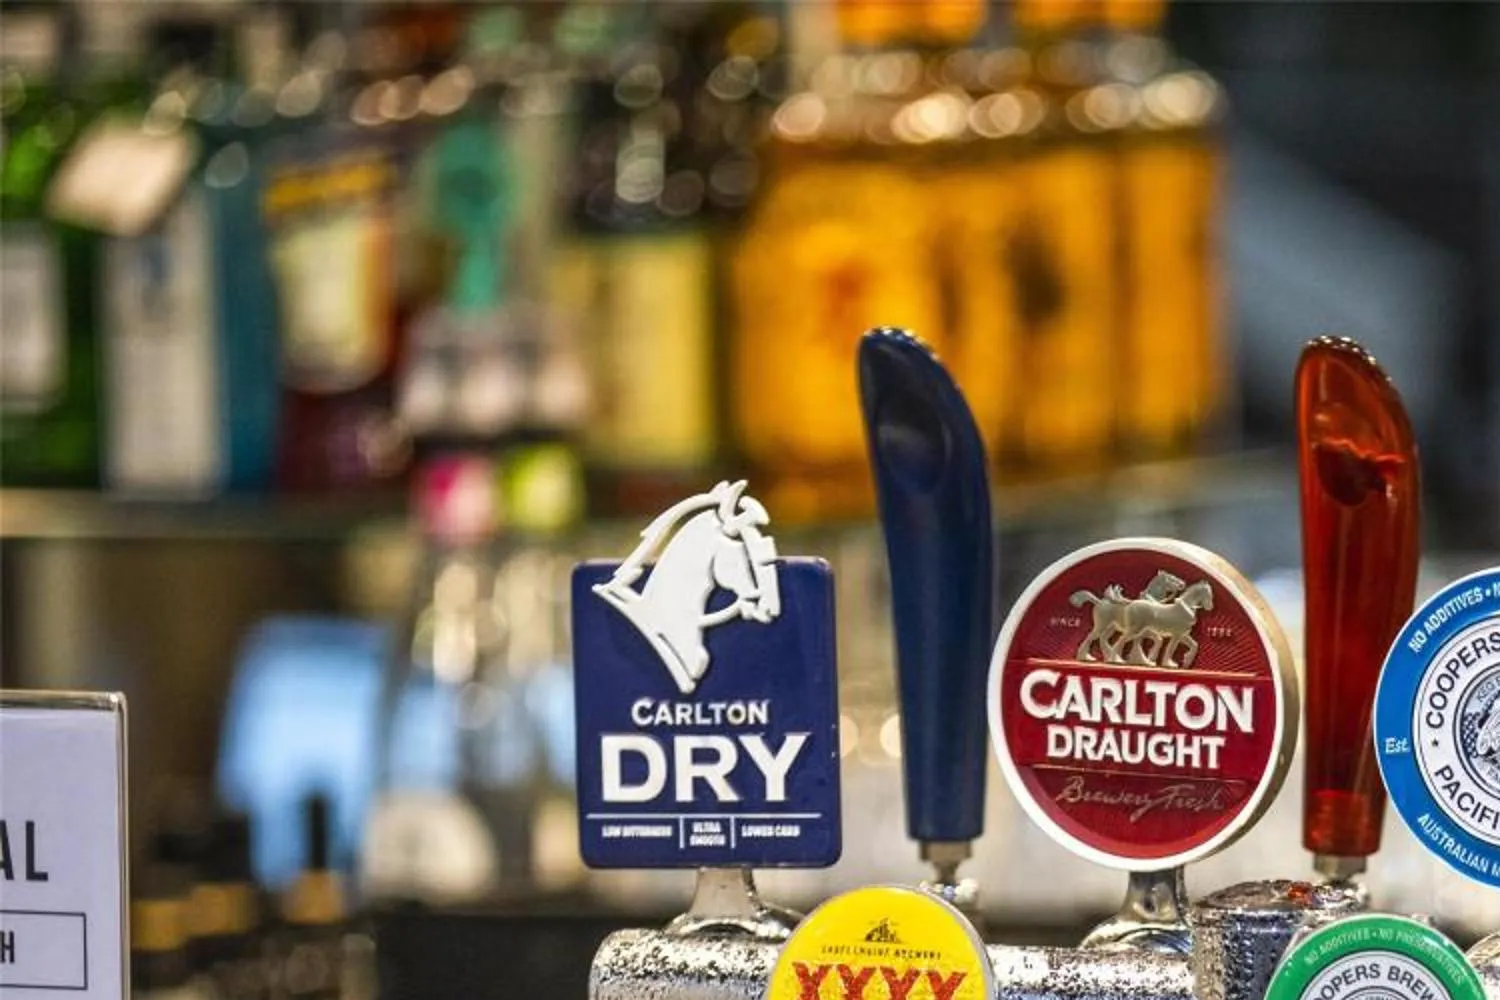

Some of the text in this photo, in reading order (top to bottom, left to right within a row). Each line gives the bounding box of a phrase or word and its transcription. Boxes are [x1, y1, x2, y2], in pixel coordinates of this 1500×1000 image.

[1408, 631, 1426, 654] NO
[1423, 587, 1484, 637] ADDITIVES
[631, 698, 770, 727] CARLTON
[1019, 668, 1255, 734] CARLTON
[600, 732, 811, 803] DRY
[1046, 723, 1226, 770] DRAUGHT
[1417, 812, 1490, 873] AUSTRALIAN
